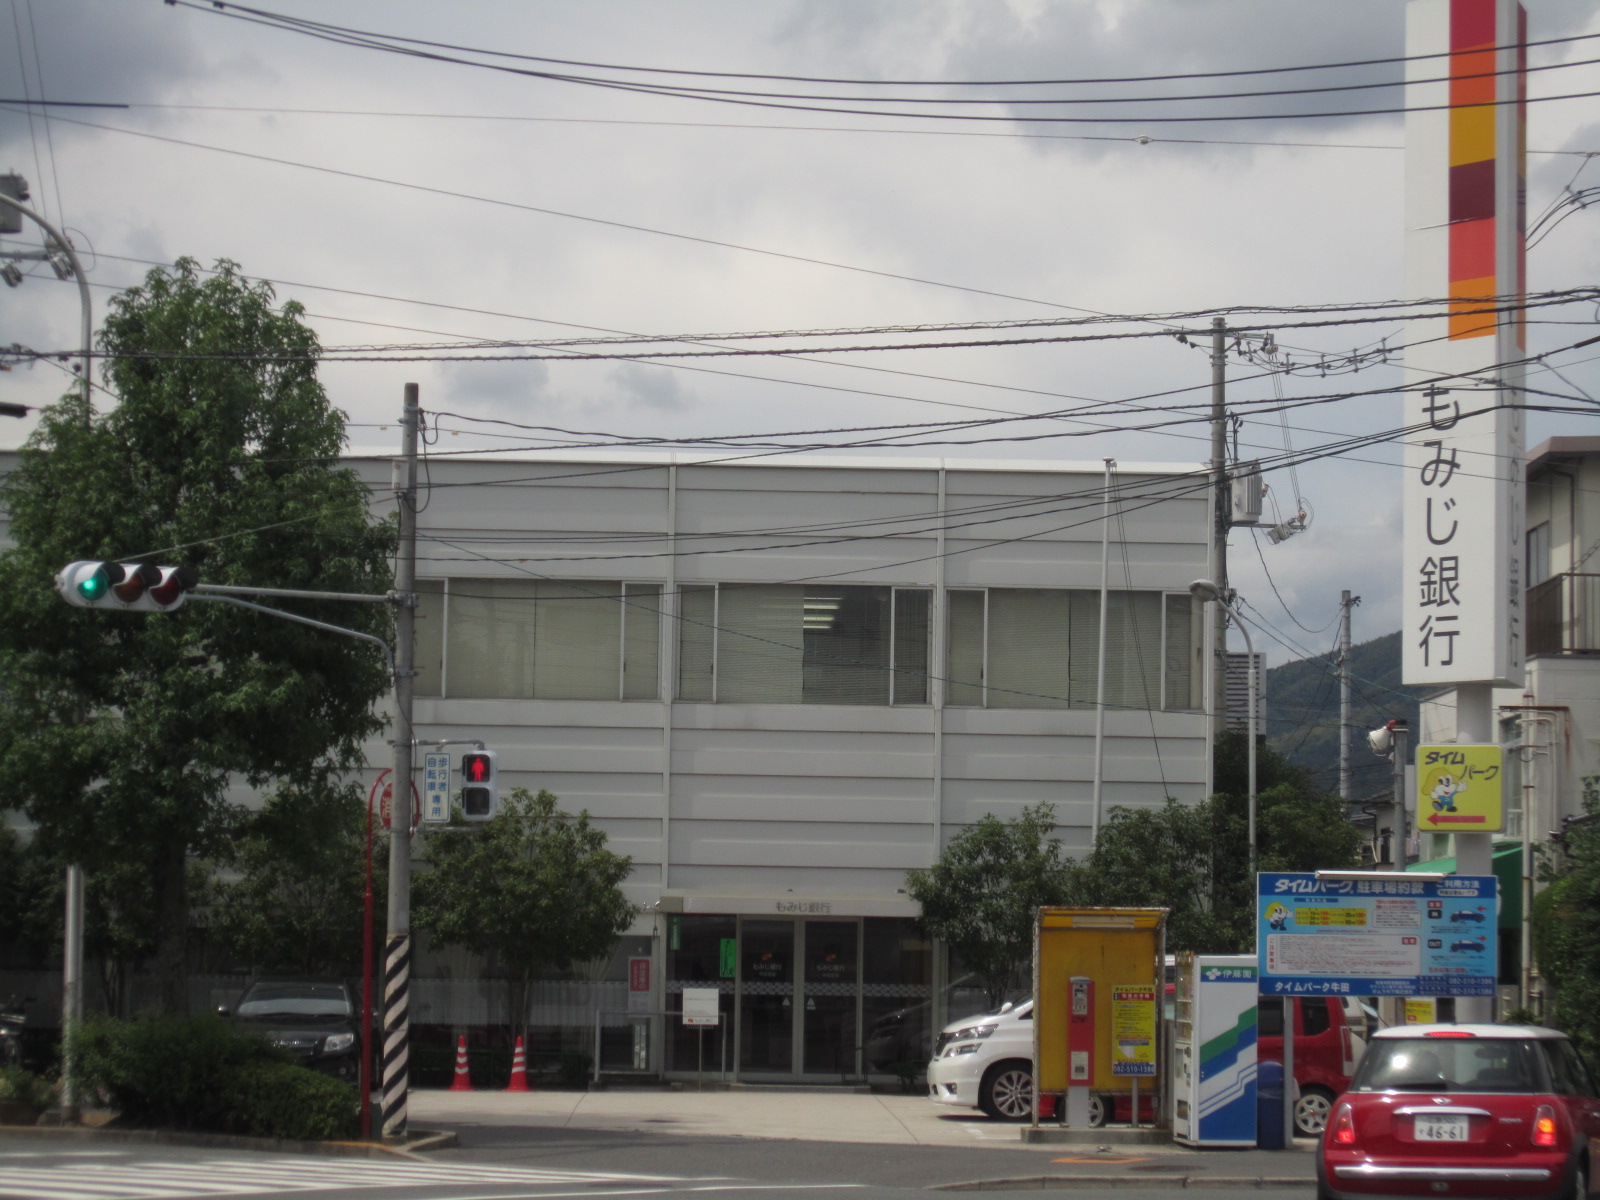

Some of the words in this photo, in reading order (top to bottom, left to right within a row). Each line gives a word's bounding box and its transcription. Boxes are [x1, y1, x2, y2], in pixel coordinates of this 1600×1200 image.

[1419, 383, 1461, 668] もみじ銀行
[1425, 751, 1465, 765] タイム
[1459, 765, 1499, 780] パーク
[1274, 879, 1352, 893] タイムパーク
[776, 902, 831, 913] もみじ銀行
[1223, 970, 1251, 978] 伊藤園
[1275, 982, 1349, 992] タイムパーク牛田
[1427, 1125, 1464, 1140] 46-61
